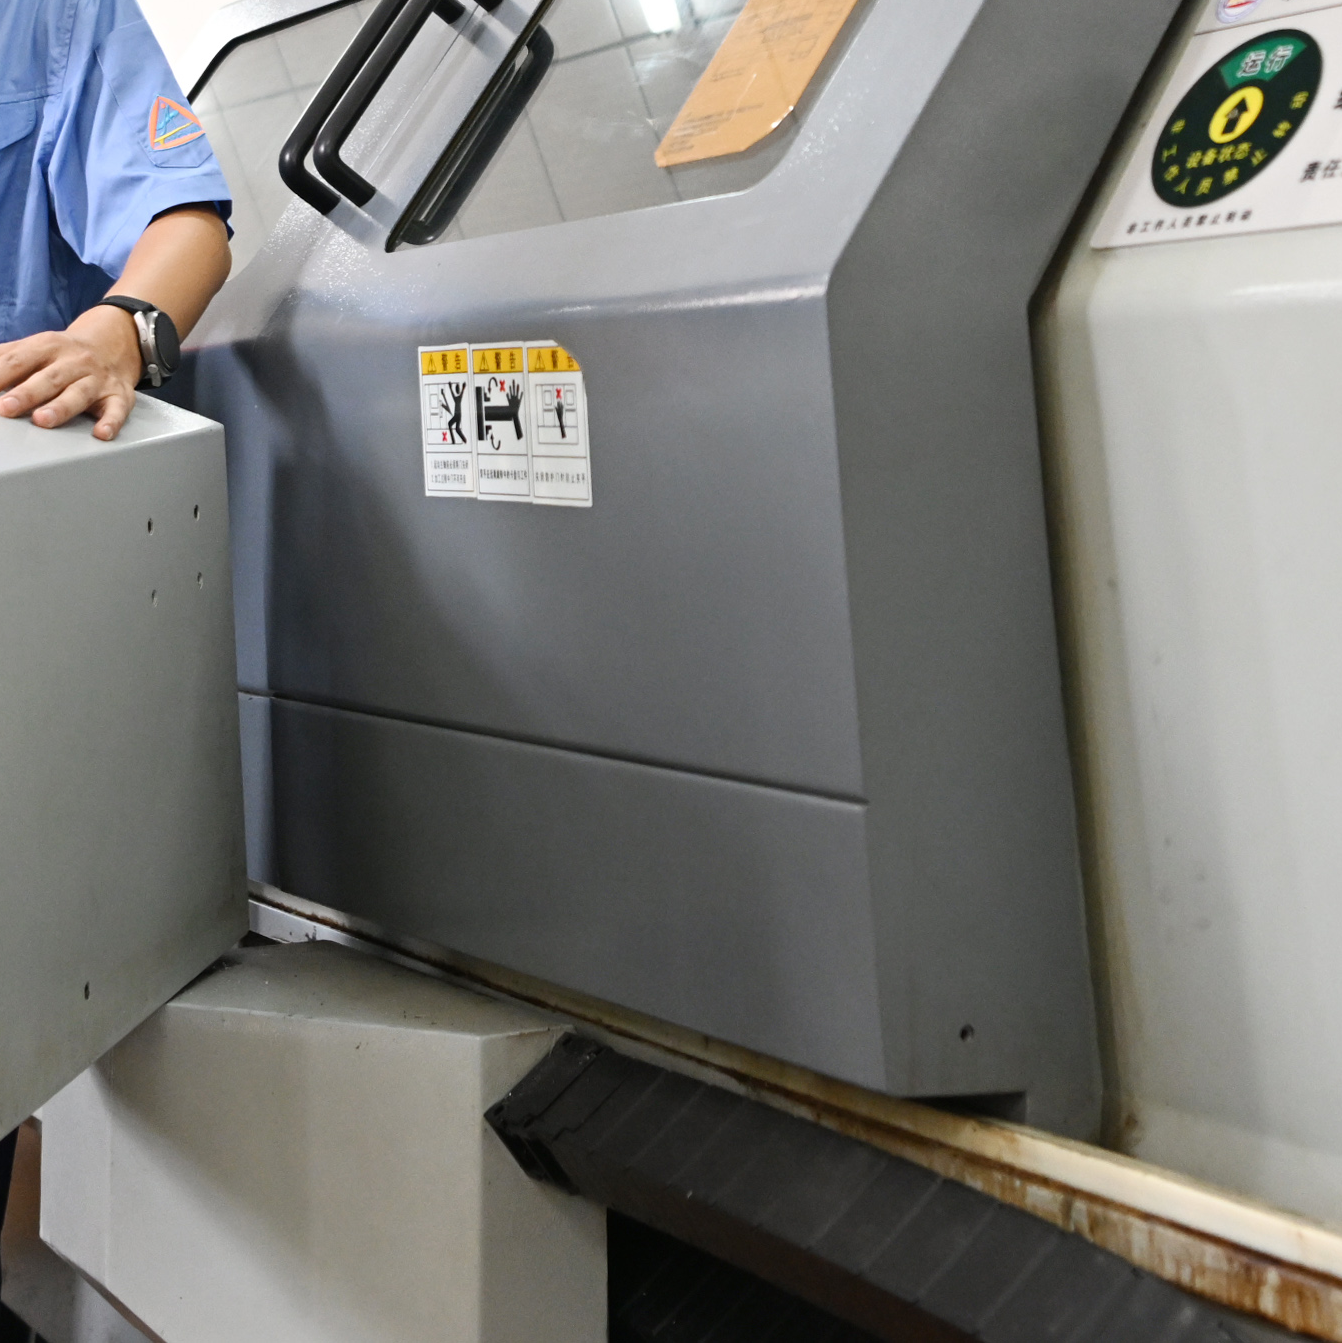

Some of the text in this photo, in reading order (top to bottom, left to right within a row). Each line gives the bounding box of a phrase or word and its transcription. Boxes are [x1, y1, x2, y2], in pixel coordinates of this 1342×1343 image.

[1236, 44, 1294, 78] 运行
[1185, 141, 1253, 170] 设备状态
